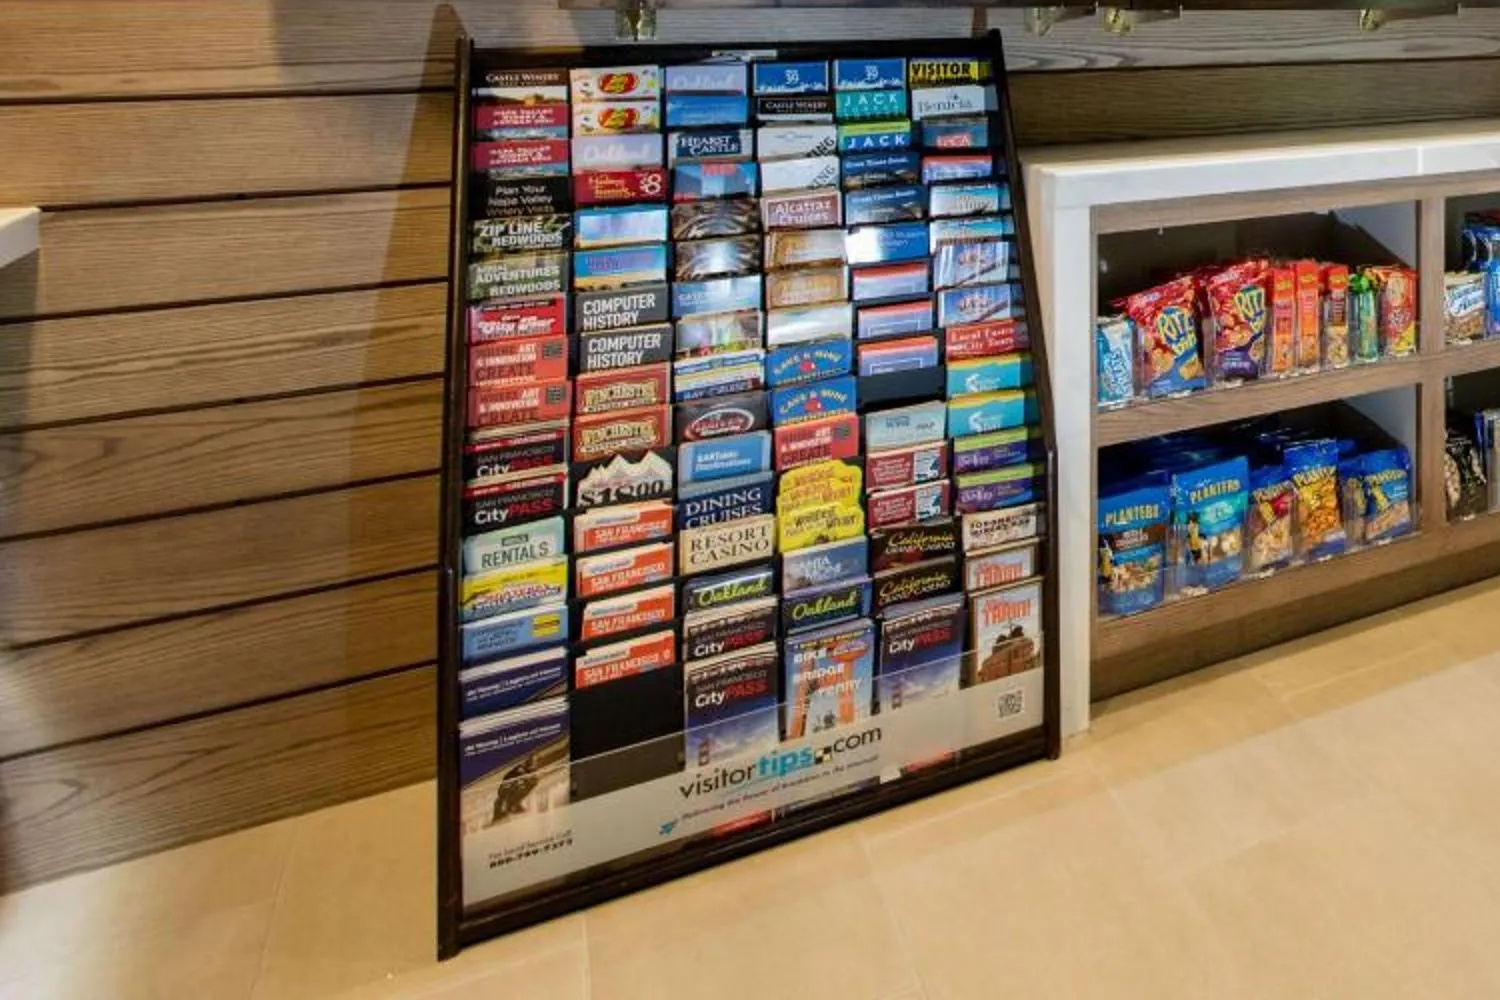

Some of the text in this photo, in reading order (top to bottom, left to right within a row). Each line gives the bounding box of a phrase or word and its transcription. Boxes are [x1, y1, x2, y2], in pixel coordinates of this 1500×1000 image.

[911, 62, 971, 75] VISITOR
[844, 92, 898, 106] JACK
[681, 134, 730, 147] HEARST
[689, 143, 739, 157] CASTLE
[848, 134, 905, 148] JACK
[775, 200, 832, 214] Alcatraz
[480, 221, 543, 237] ZIP LINE
[491, 232, 563, 247] REDWOODS
[475, 265, 561, 284] ADVENTURES
[489, 279, 561, 297] REDWOODS
[583, 293, 656, 315] COMPUTER
[583, 311, 639, 331] HISTORY
[588, 332, 661, 354] COMPUTER
[587, 350, 645, 369] HISTORY
[685, 487, 761, 515] DINING
[1191, 479, 1241, 505] PLANTERS
[685, 502, 763, 529] CRUISES
[1105, 503, 1159, 527] PLANTERS
[690, 525, 768, 553] RESORT
[481, 540, 549, 568] RENTALS
[690, 538, 769, 566] CASINO
[699, 576, 769, 606] Oakland
[792, 590, 858, 620] Oakland
